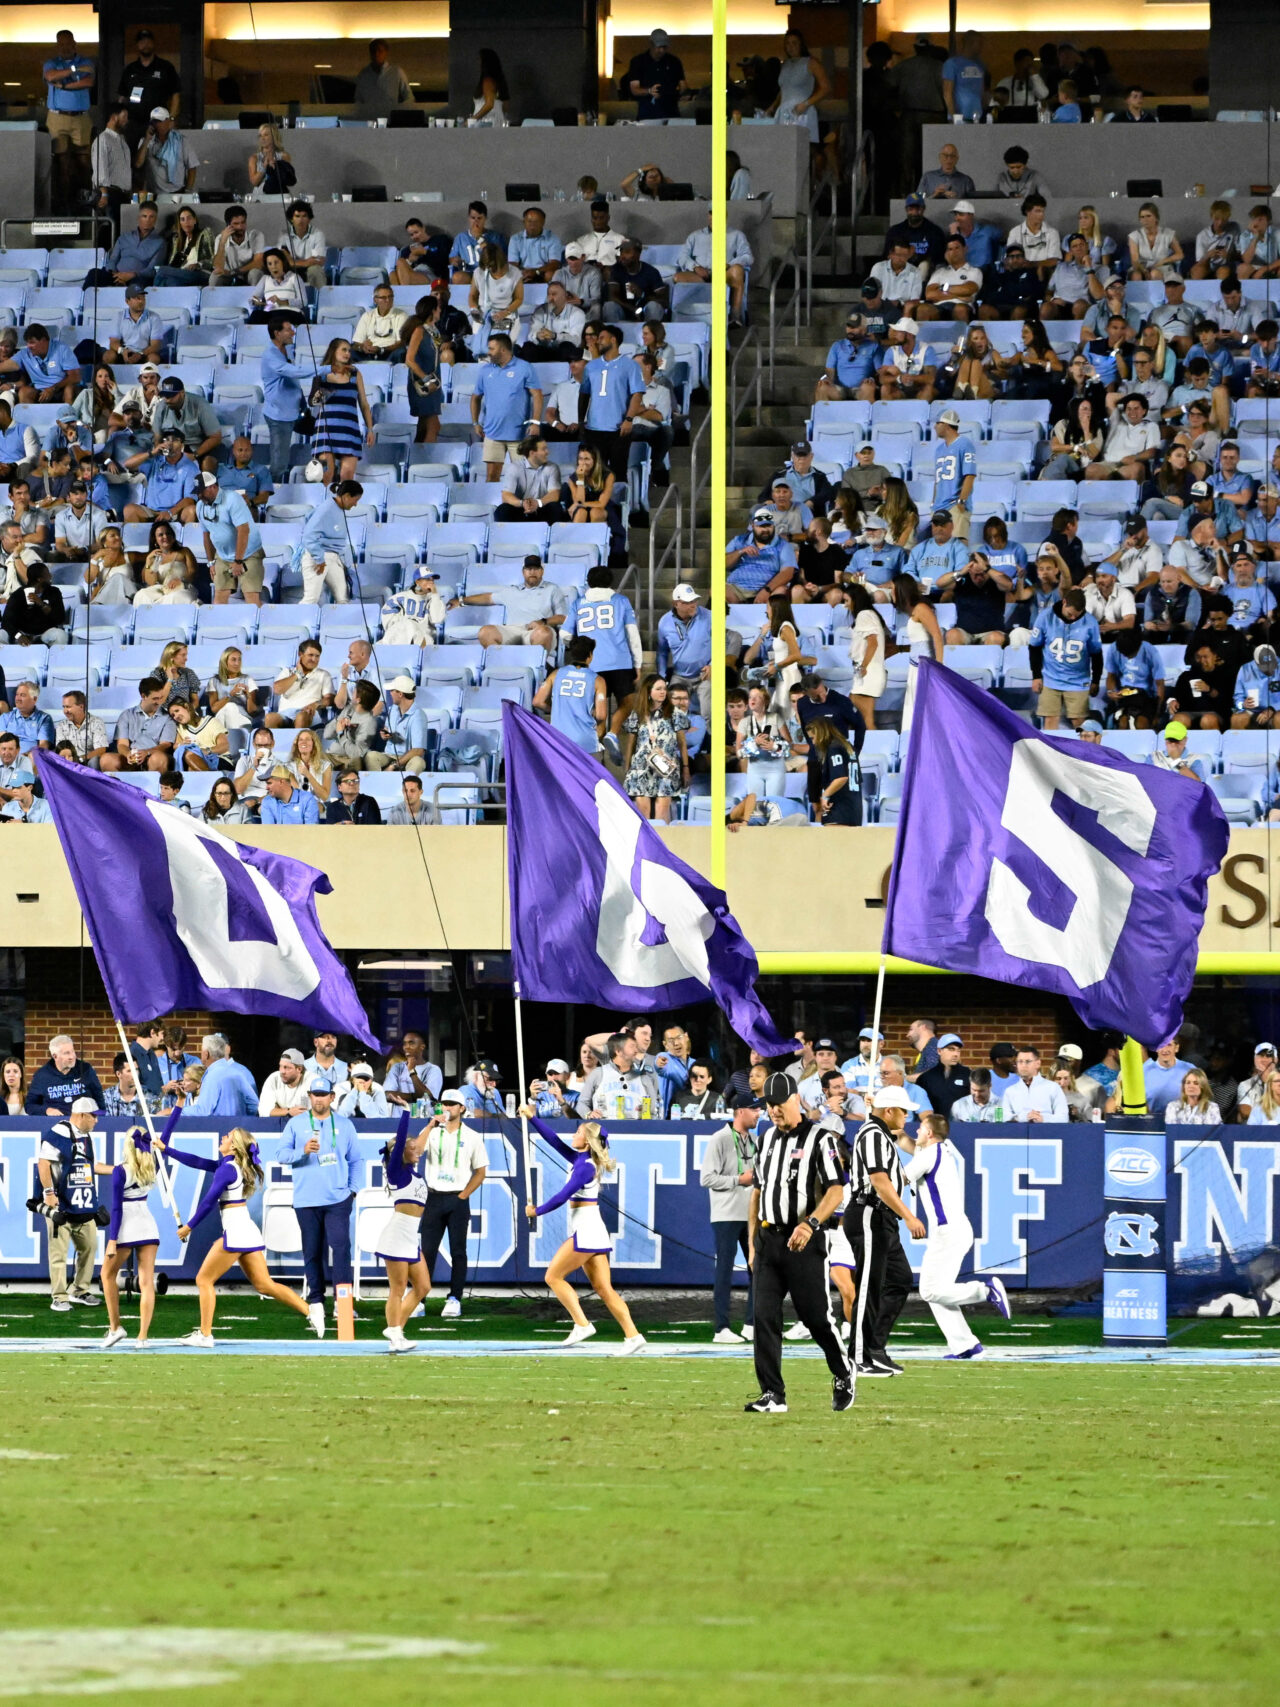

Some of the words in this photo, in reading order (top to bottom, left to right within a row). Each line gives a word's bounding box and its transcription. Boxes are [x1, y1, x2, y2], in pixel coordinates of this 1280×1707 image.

[599, 369, 608, 396] 1
[577, 604, 615, 633] 28
[1049, 637, 1084, 664] 49
[559, 678, 587, 698] 23
[831, 754, 843, 767] 10
[984, 739, 1157, 989] S
[1111, 1157, 1153, 1171] ACC
[70, 1187, 93, 1208] 42
[896, 1138, 1063, 1275] F
